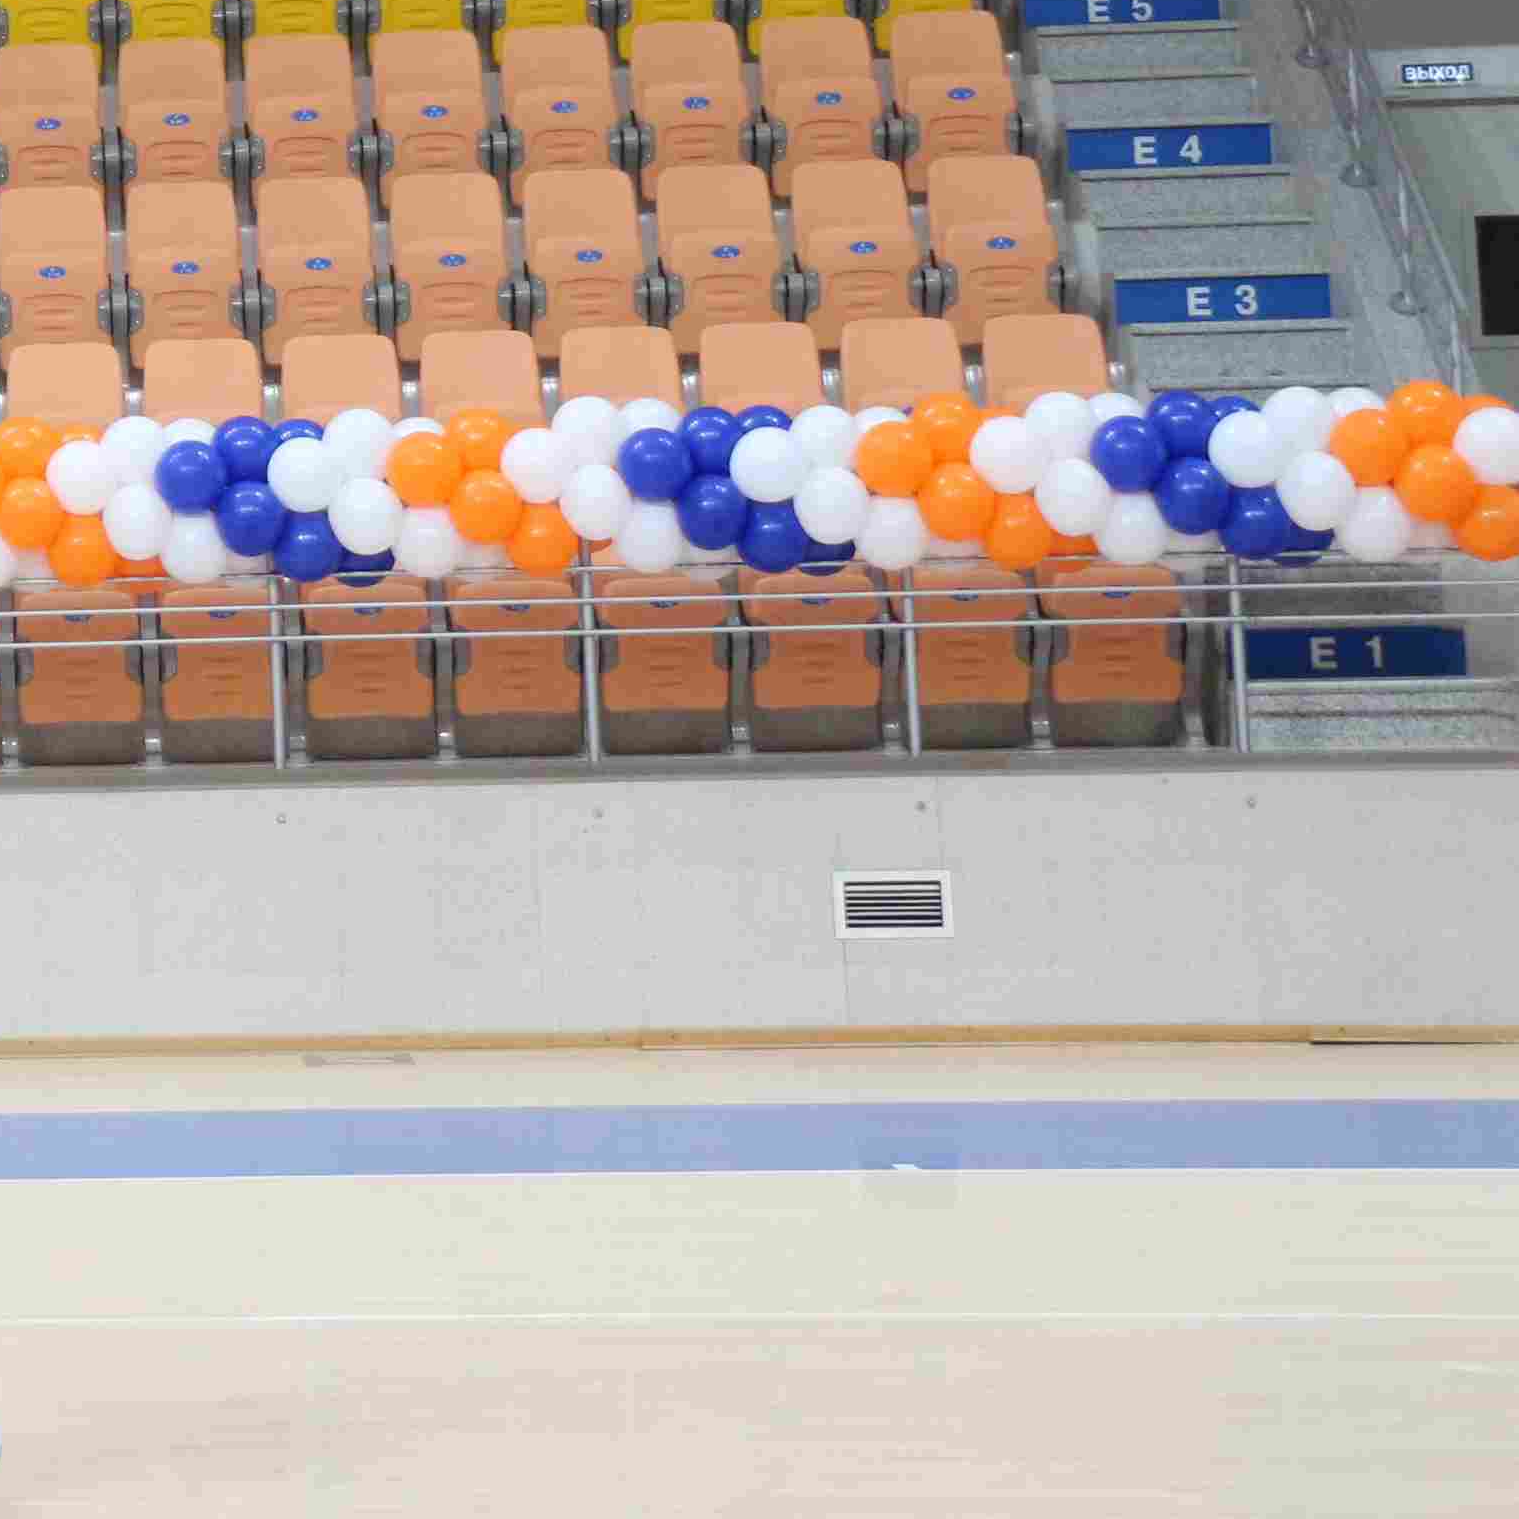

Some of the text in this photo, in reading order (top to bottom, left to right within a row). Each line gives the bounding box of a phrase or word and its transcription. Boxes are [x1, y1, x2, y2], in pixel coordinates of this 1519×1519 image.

[1404, 65, 1470, 81] ВЫХОД
[1133, 134, 1202, 165] E 4
[1186, 284, 1259, 317] E 3
[1310, 635, 1383, 669] E 1
